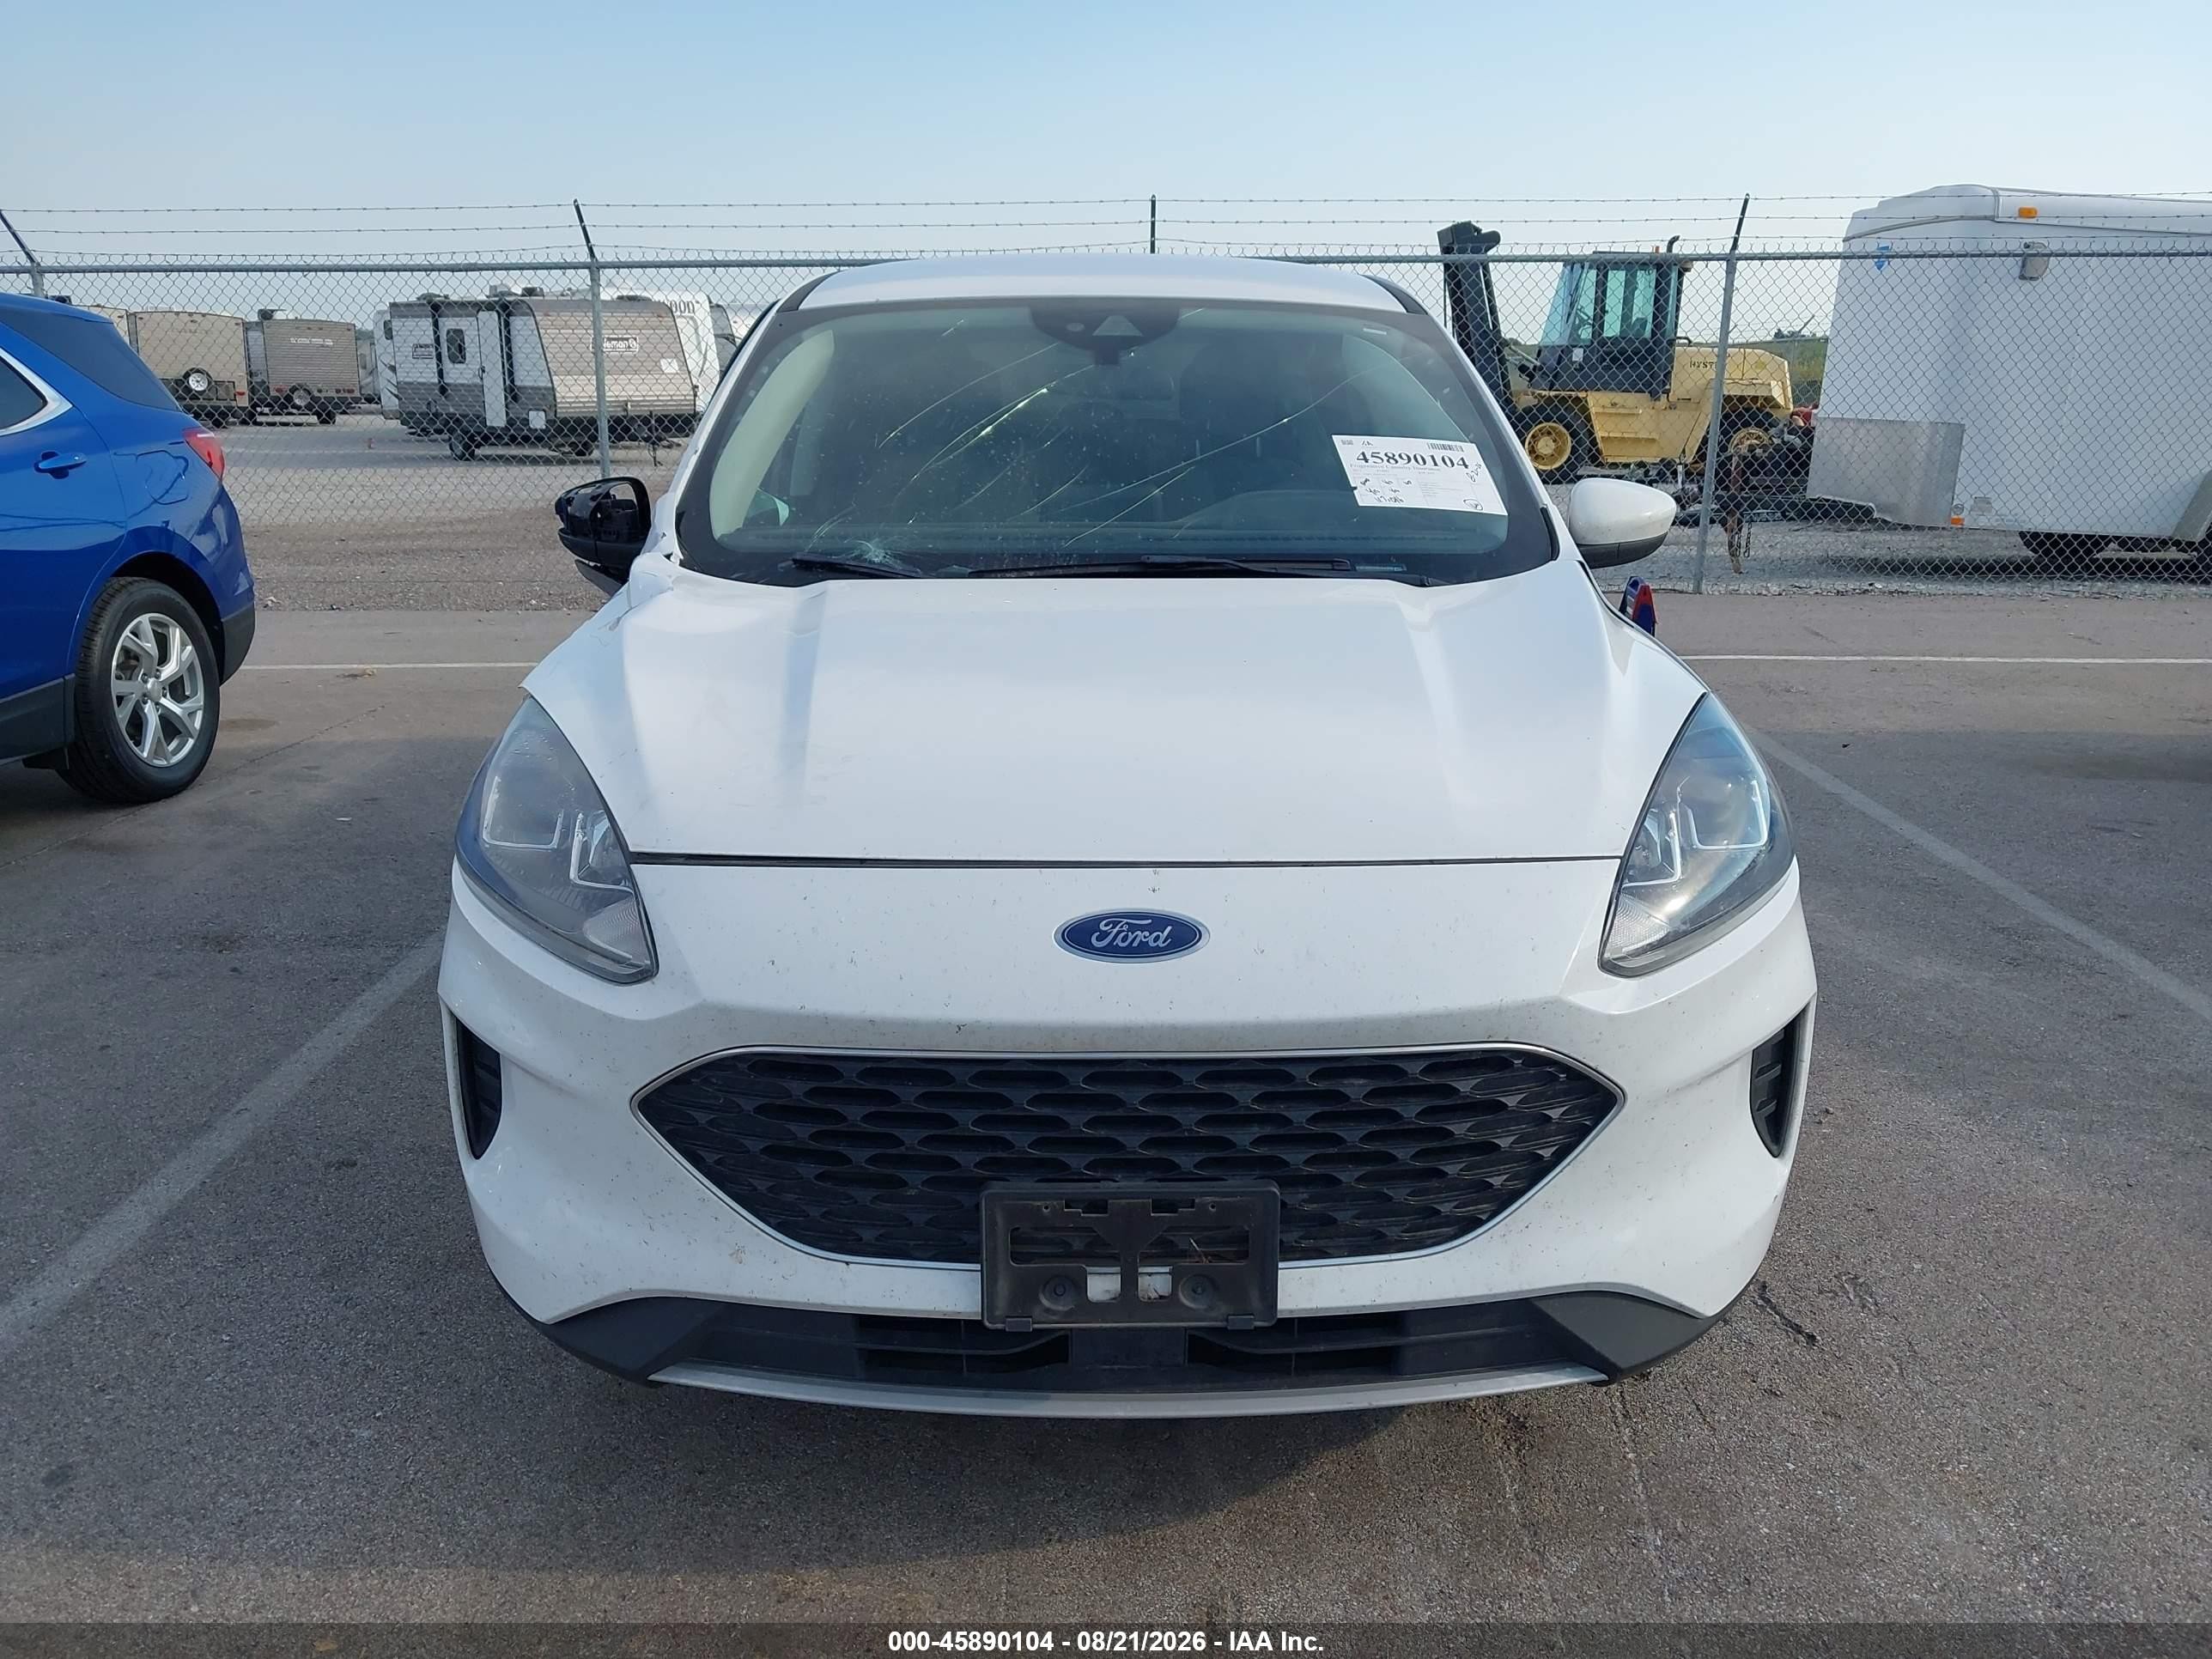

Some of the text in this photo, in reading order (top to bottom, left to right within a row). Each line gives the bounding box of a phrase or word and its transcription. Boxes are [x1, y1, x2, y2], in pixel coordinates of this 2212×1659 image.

[1689, 360, 1718, 369] HYST
[1357, 451, 1469, 470] 45890104
[1091, 918, 1172, 948] Ford
